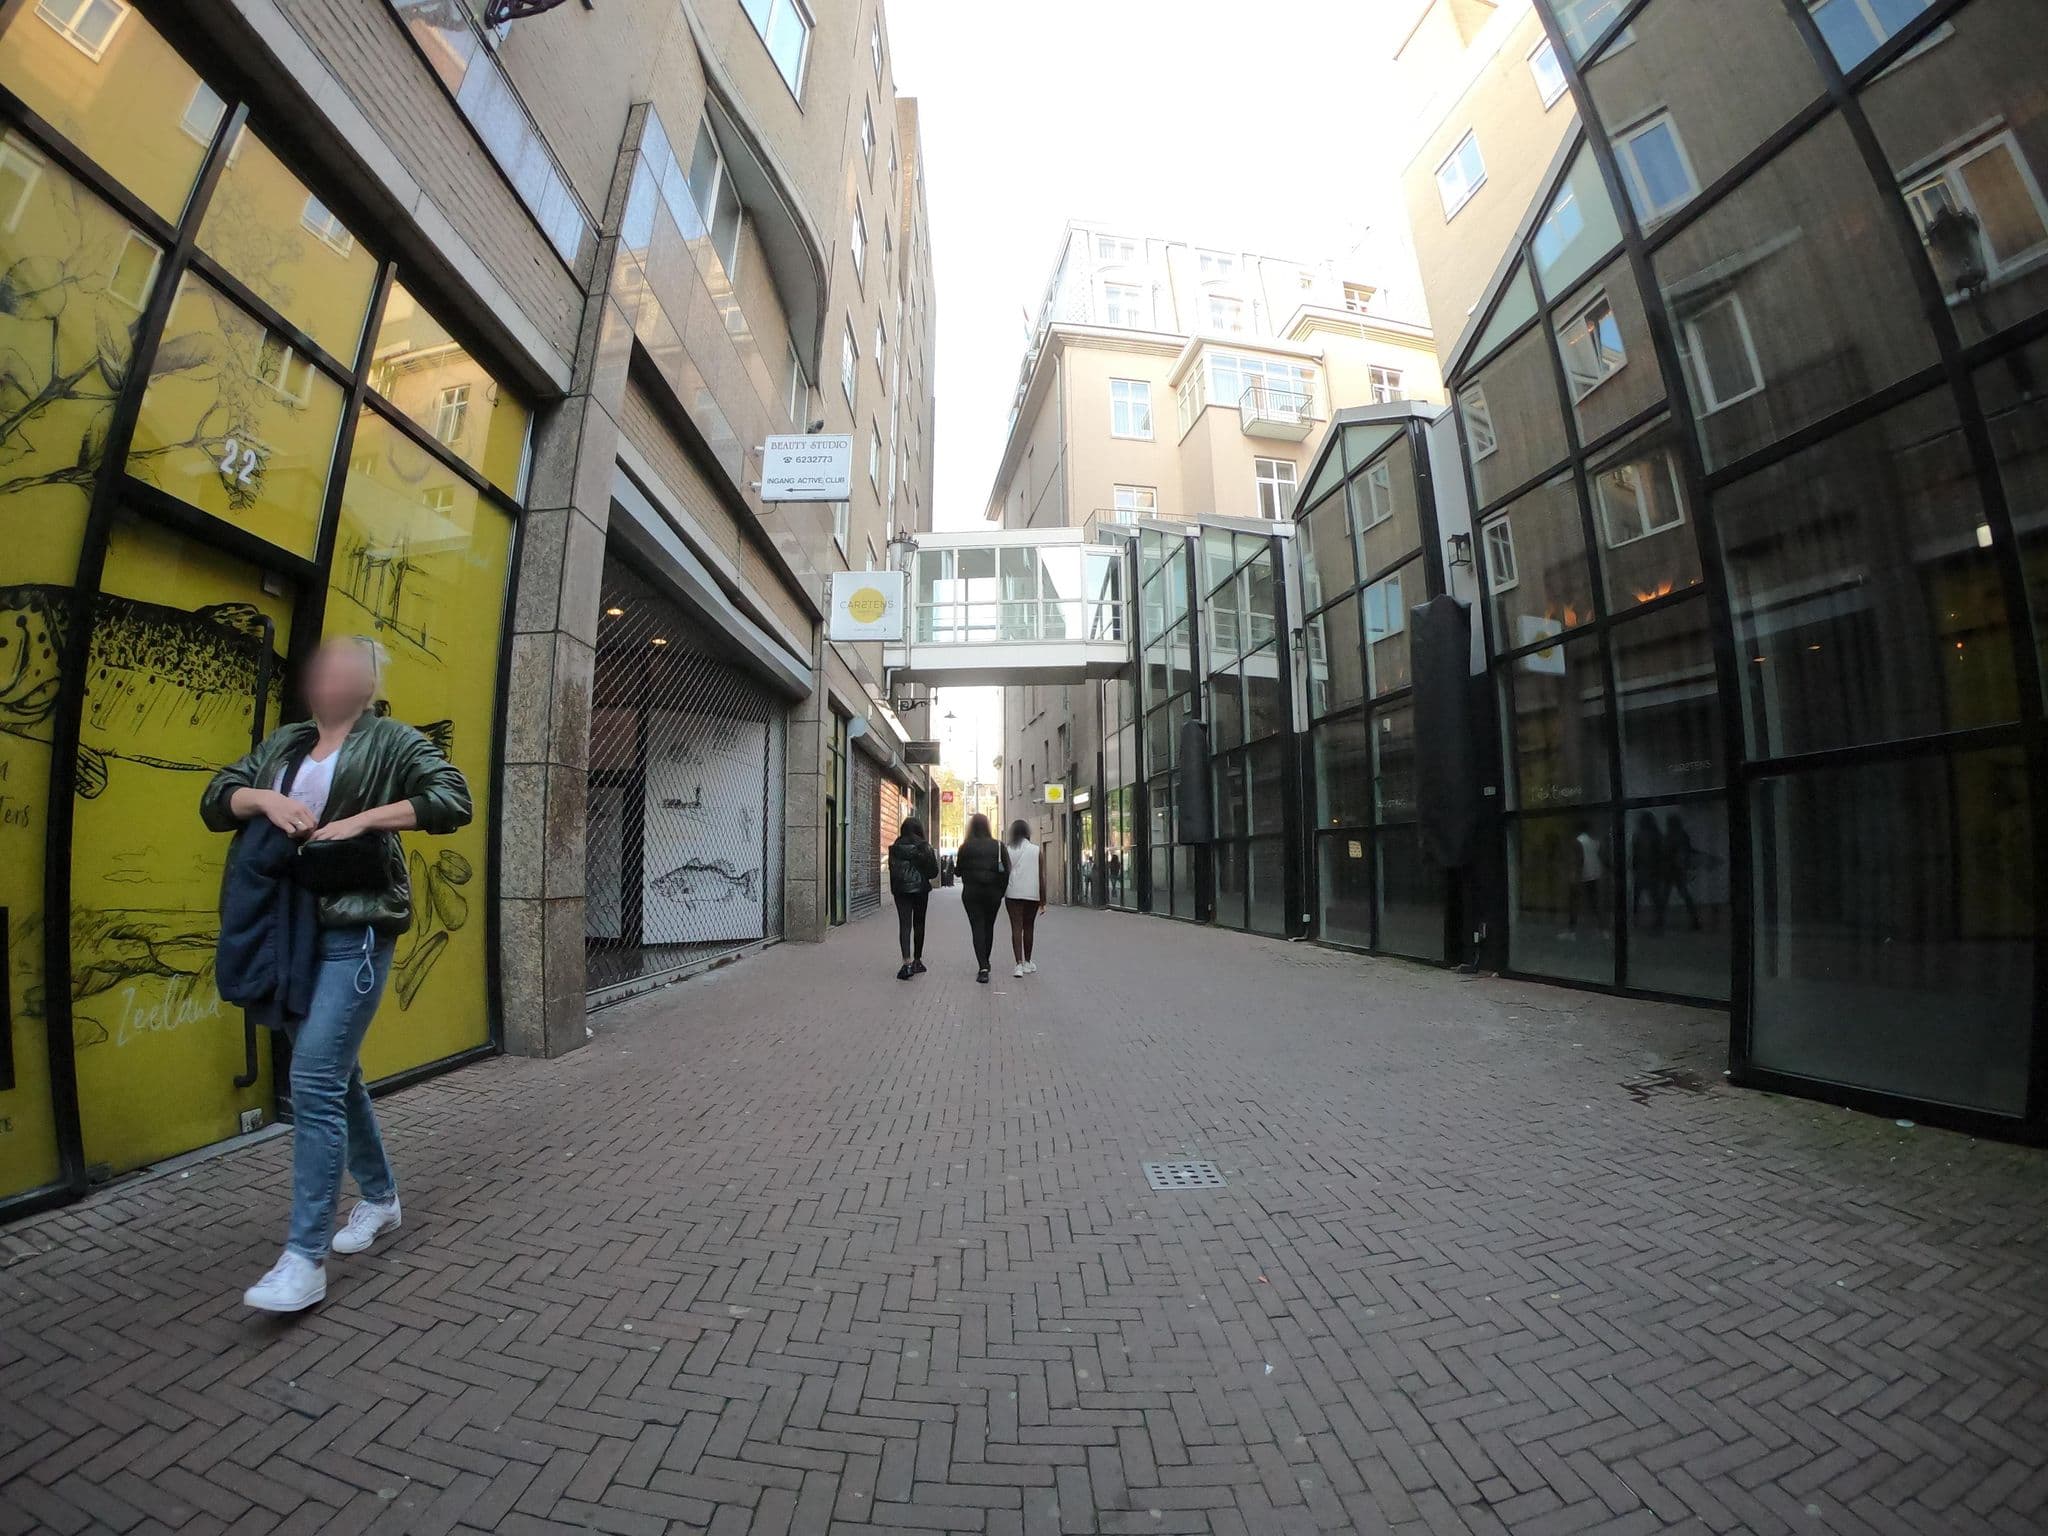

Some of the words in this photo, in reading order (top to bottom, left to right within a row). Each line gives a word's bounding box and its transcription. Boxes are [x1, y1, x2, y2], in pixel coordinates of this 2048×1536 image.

[770, 440, 807, 450] BEAUTY
[810, 440, 848, 450] STUDIO
[220, 438, 256, 485] 22
[795, 455, 833, 464] 6232773
[766, 477, 795, 485] INGANG
[797, 476, 823, 484] ACTIVE
[825, 476, 845, 484] CLUB
